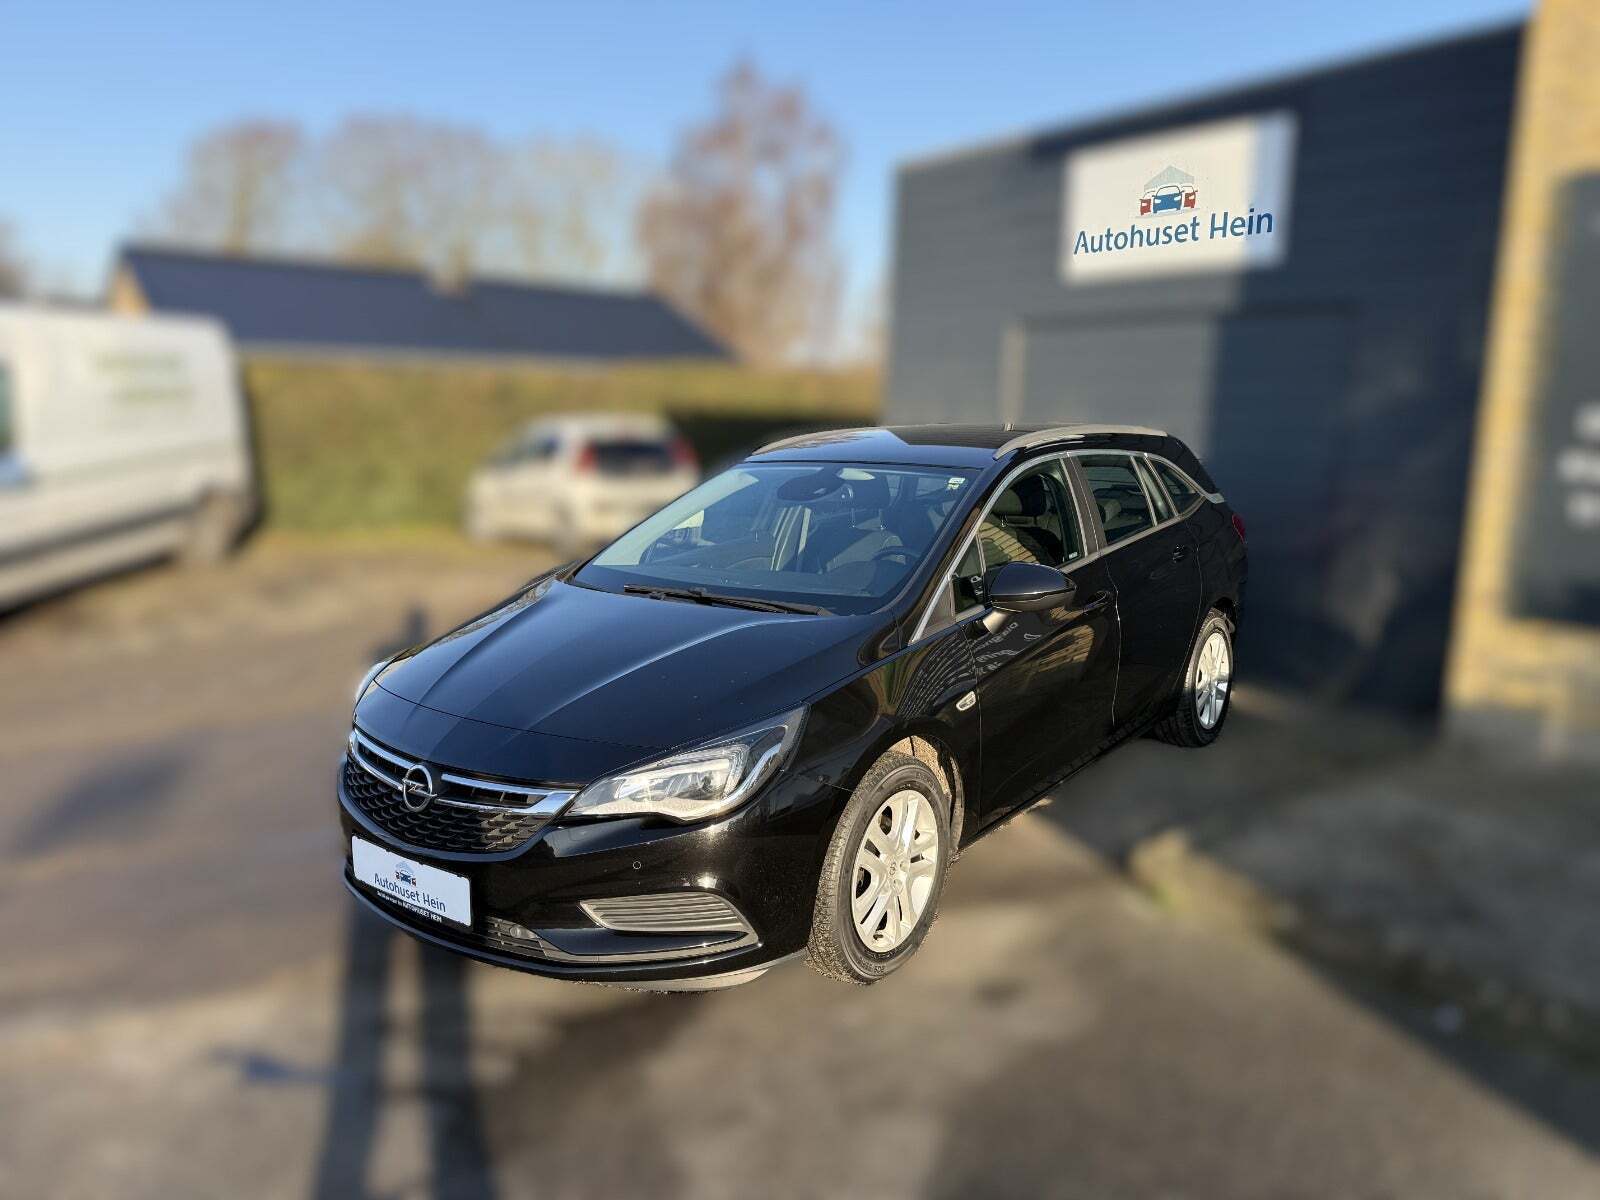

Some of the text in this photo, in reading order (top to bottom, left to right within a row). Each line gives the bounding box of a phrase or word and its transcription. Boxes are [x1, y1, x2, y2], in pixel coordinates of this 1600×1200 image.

[1073, 208, 1273, 255] Autohuset Hein
[374, 872, 420, 903] Autohuset
[422, 892, 446, 912] Hein
